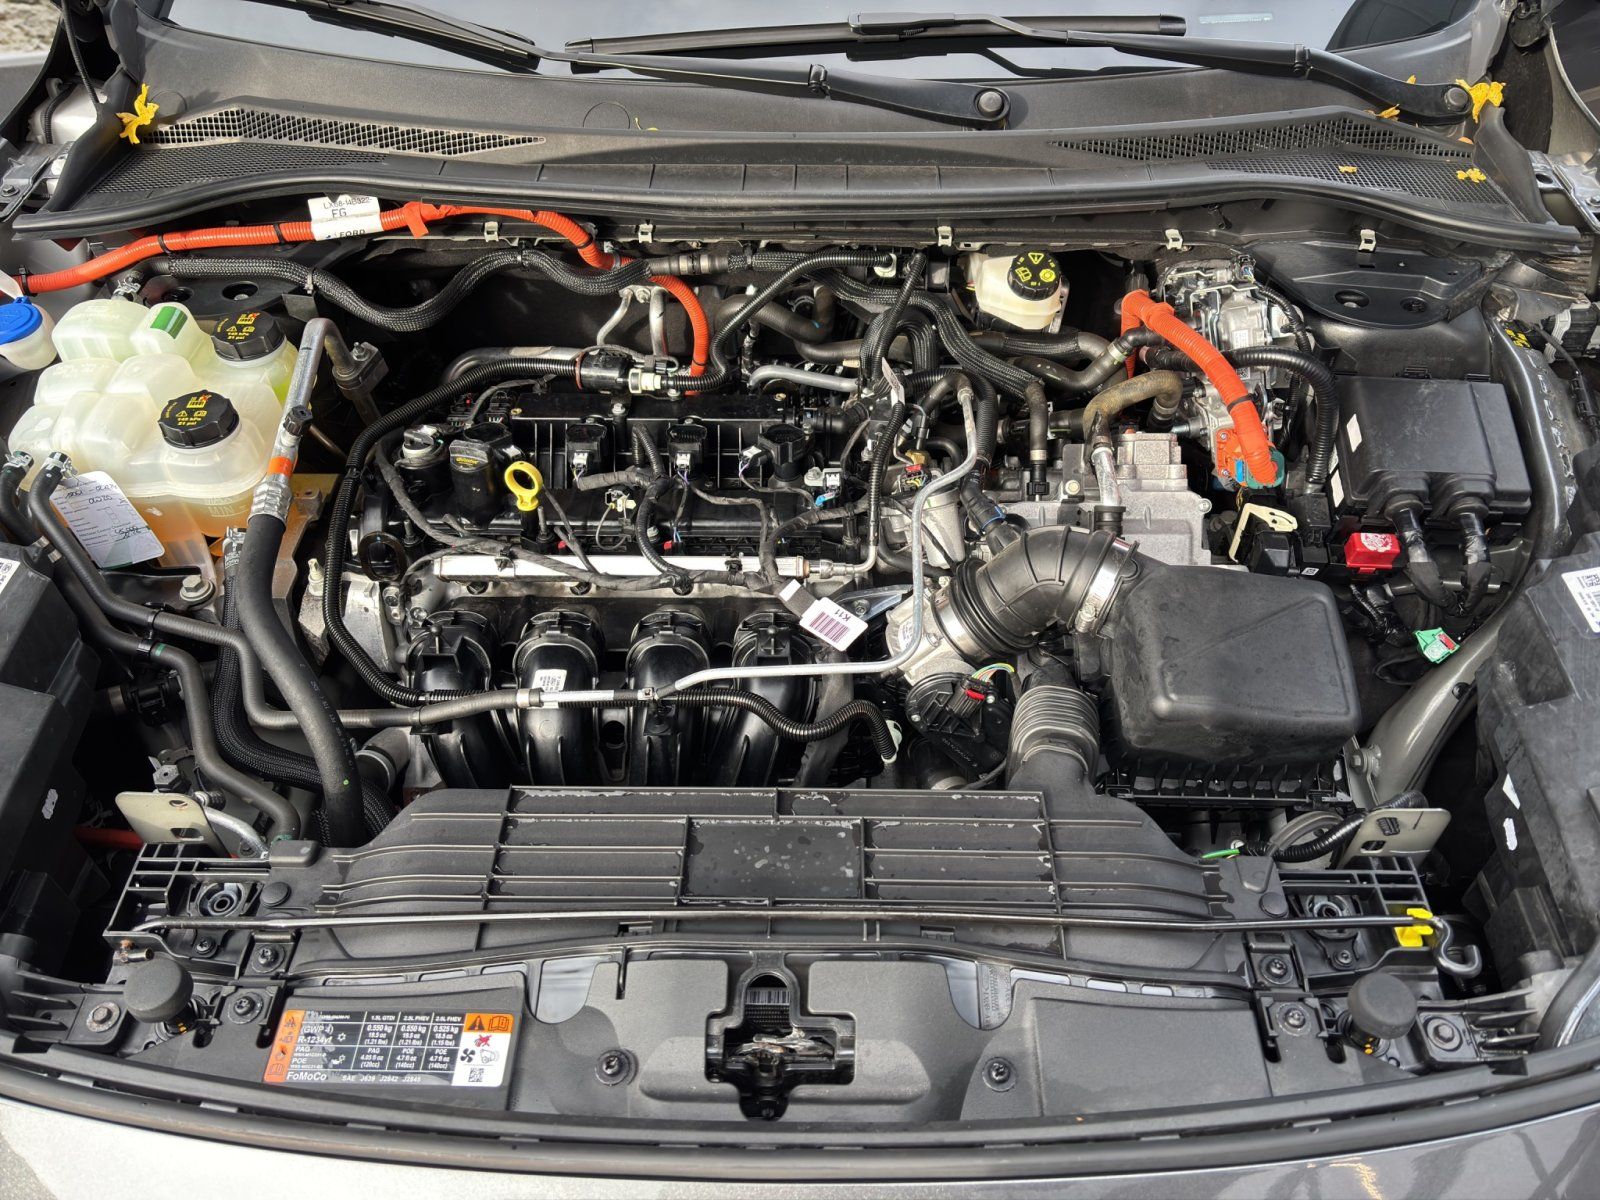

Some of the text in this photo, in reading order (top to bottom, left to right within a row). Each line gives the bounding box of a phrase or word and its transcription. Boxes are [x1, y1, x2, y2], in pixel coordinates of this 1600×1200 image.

[384, 1025, 393, 1033] kg
[418, 1026, 426, 1034] kg
[286, 1072, 327, 1081] FoMoCo
